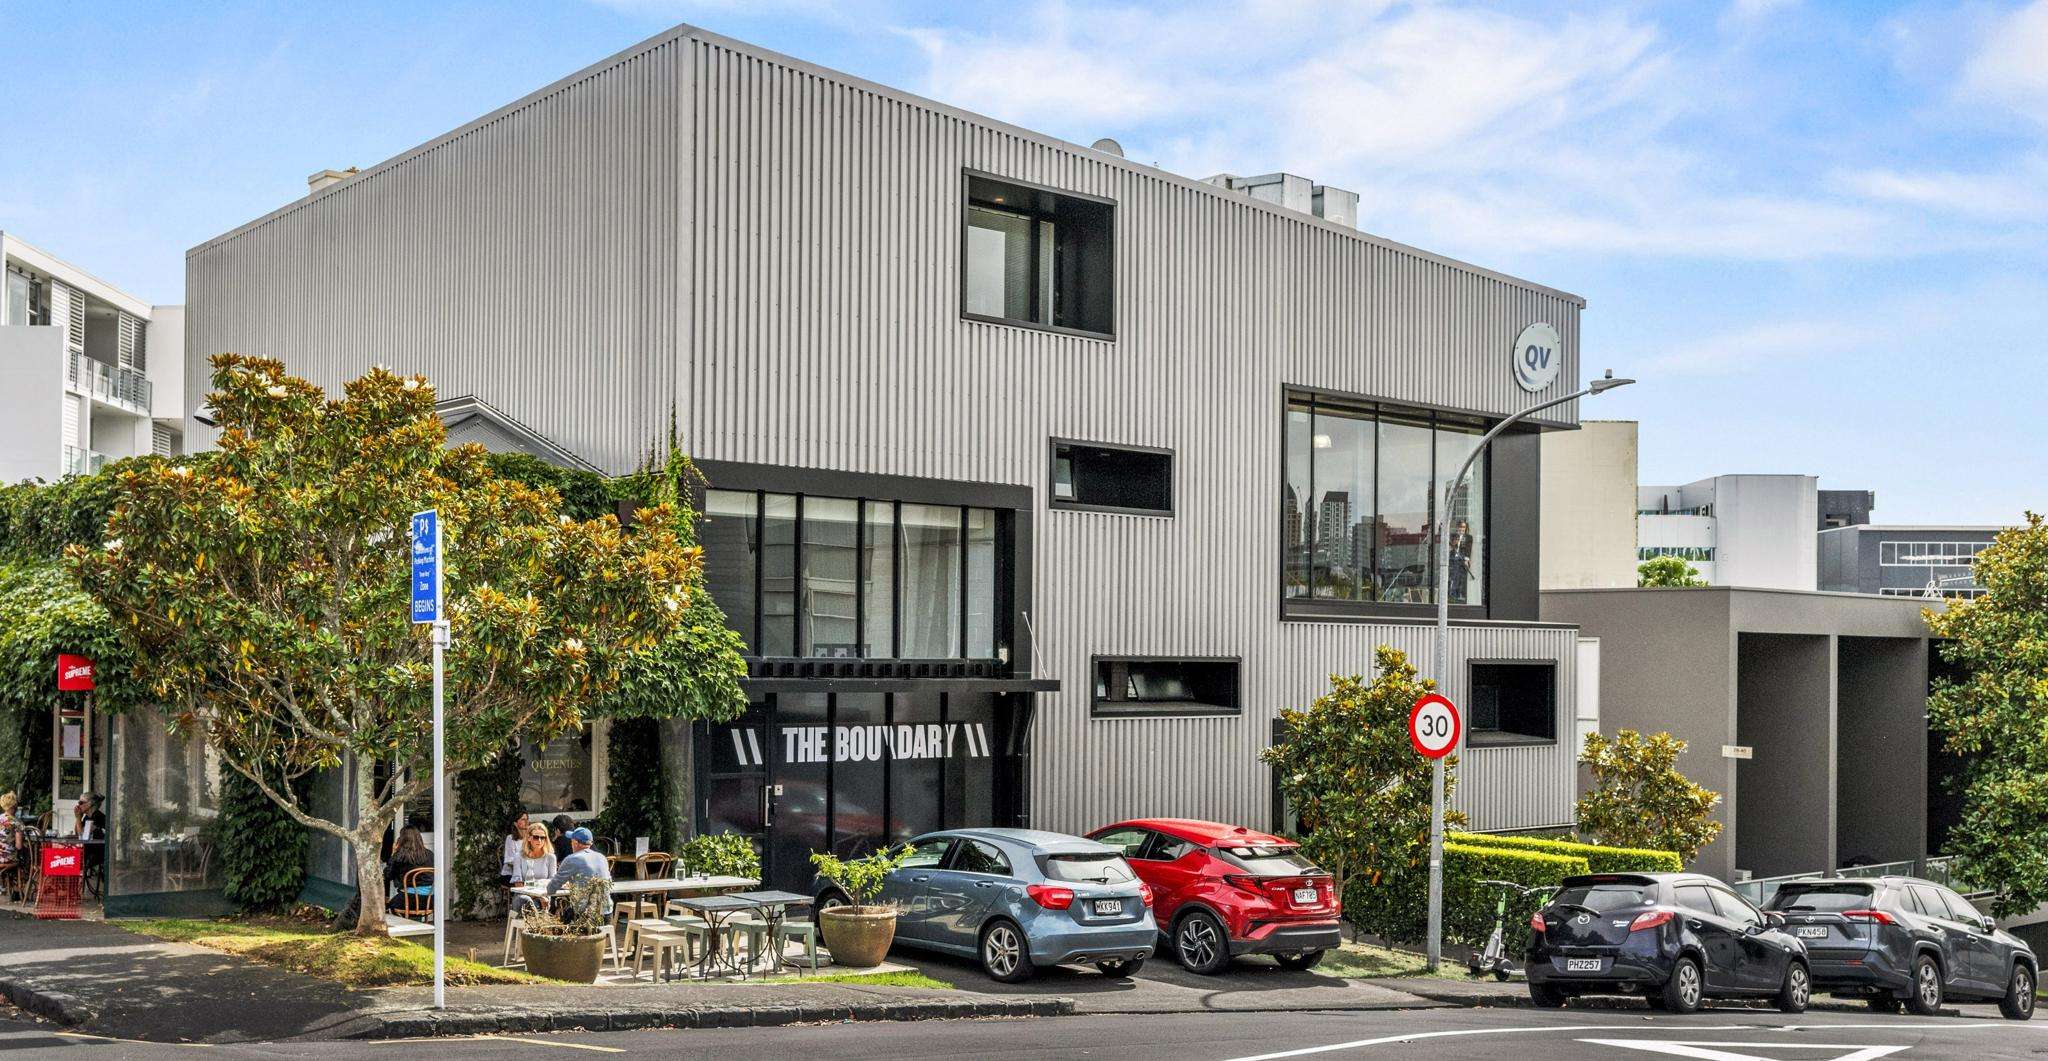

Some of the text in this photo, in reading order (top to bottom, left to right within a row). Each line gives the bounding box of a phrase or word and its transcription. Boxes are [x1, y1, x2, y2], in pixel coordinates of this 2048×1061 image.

[1525, 344, 1552, 371] QV
[415, 599, 434, 612] BEGINS
[65, 666, 92, 680] SUPREME
[1422, 714, 1447, 737] 30
[782, 727, 828, 762] THE
[531, 760, 582, 772] QUEENIES
[50, 856, 75, 868] SUPREME
[1569, 960, 1600, 970] PHZ257
